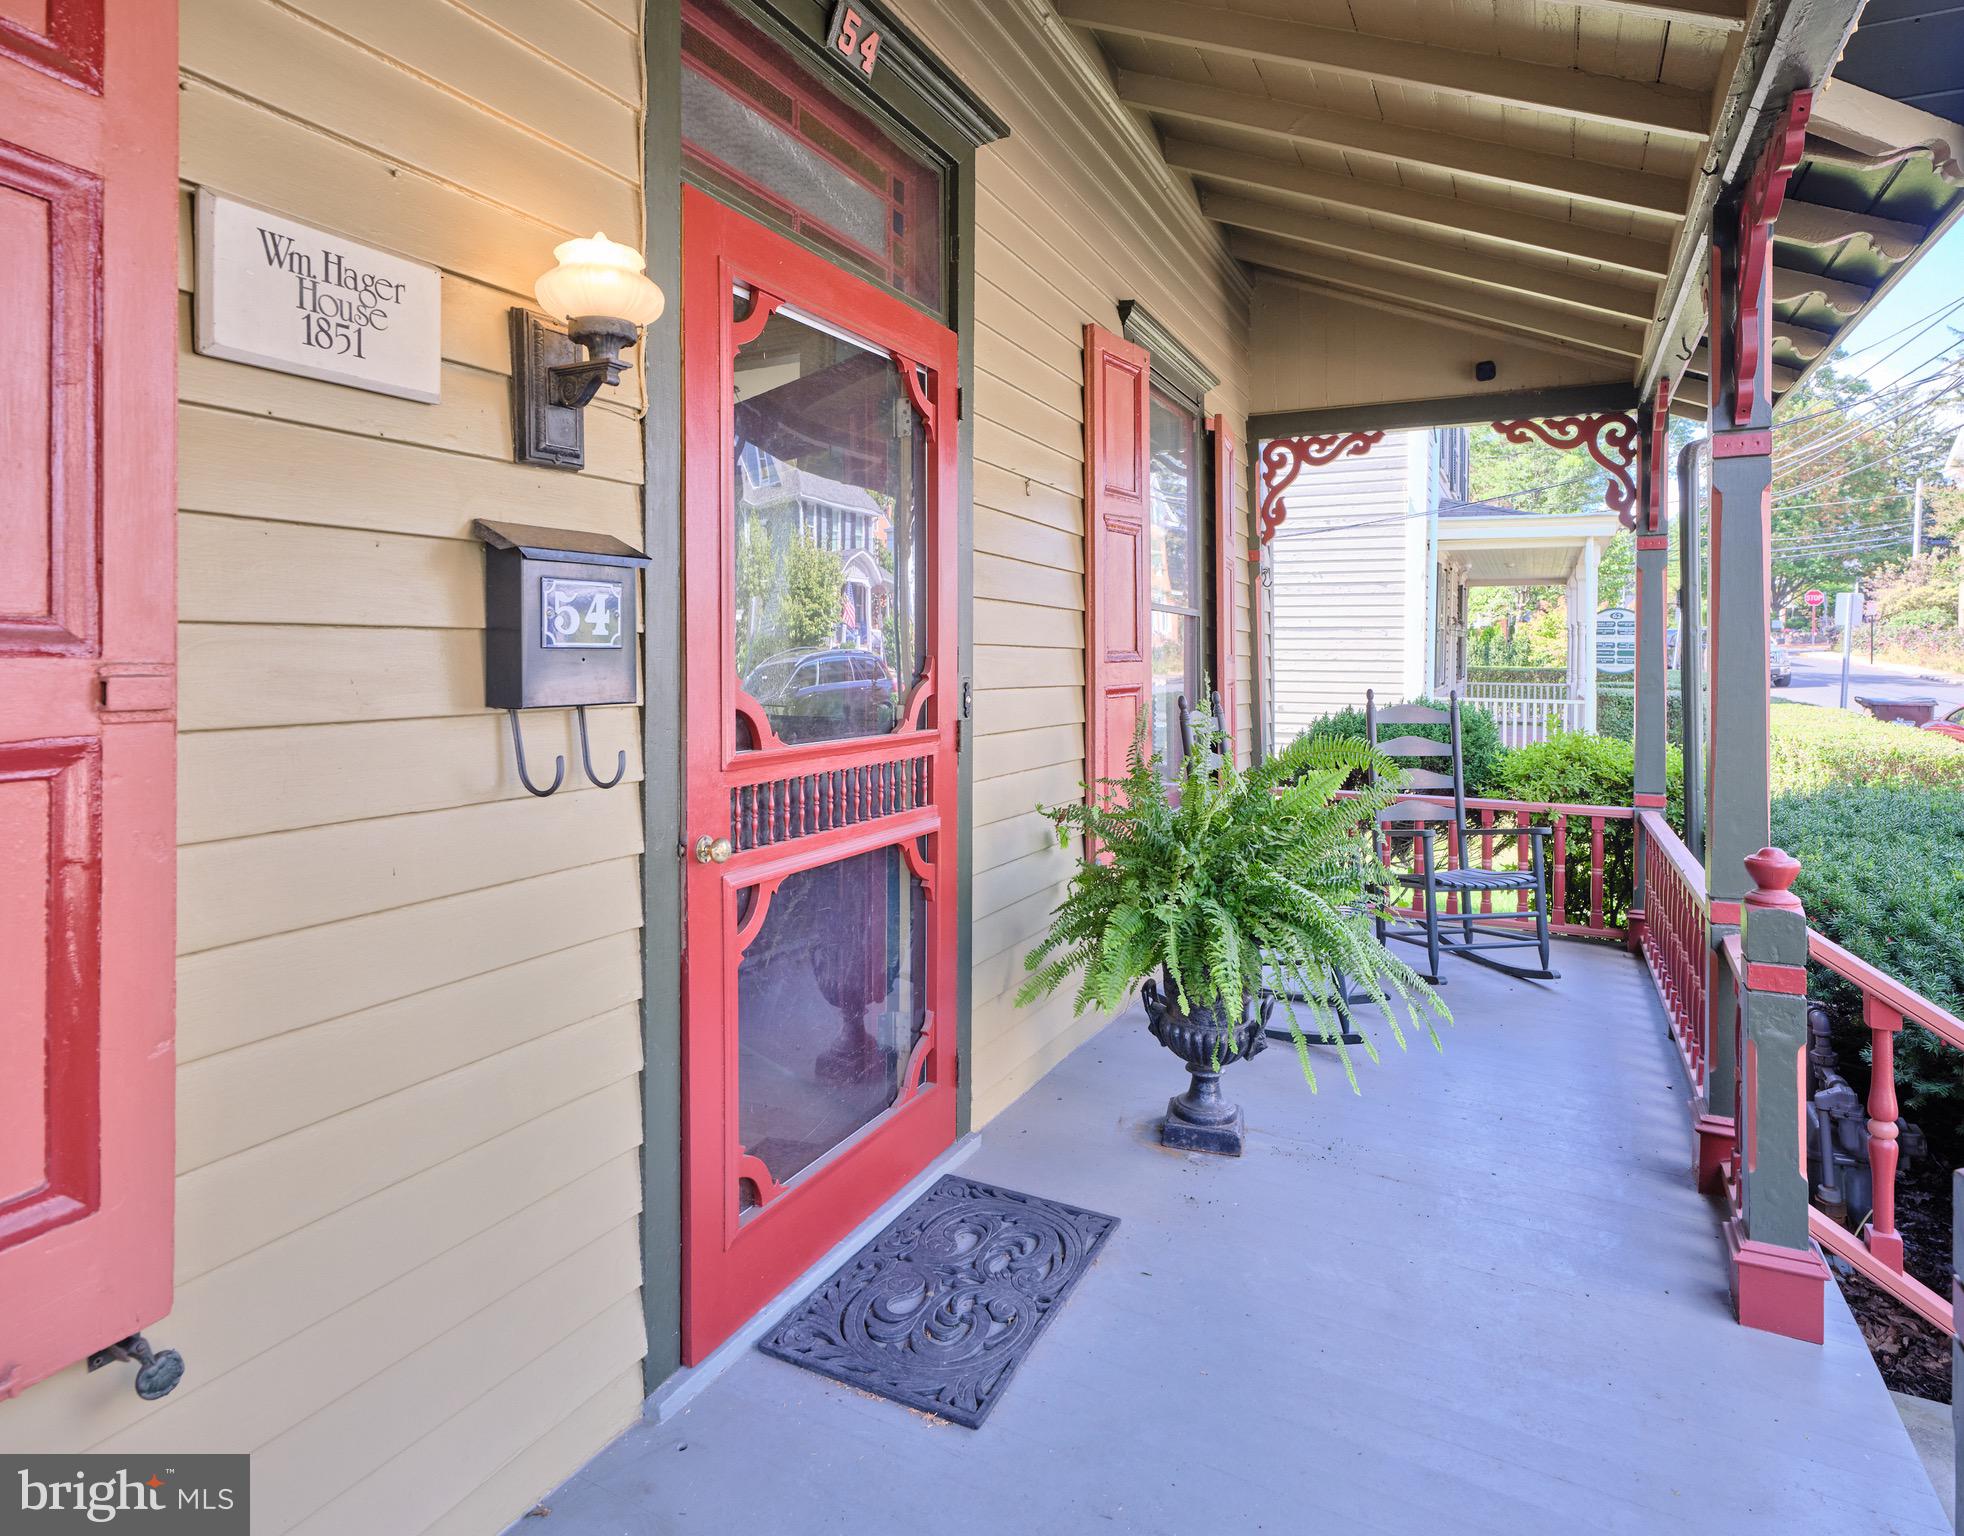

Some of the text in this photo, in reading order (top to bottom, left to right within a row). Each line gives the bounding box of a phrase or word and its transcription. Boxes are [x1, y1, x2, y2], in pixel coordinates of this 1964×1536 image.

[837, 7, 880, 75] 54
[256, 227, 406, 308] Wm. Hager
[295, 275, 389, 331] House
[301, 313, 367, 359] 1851
[554, 591, 610, 635] 54
[1806, 594, 1823, 602] STOP
